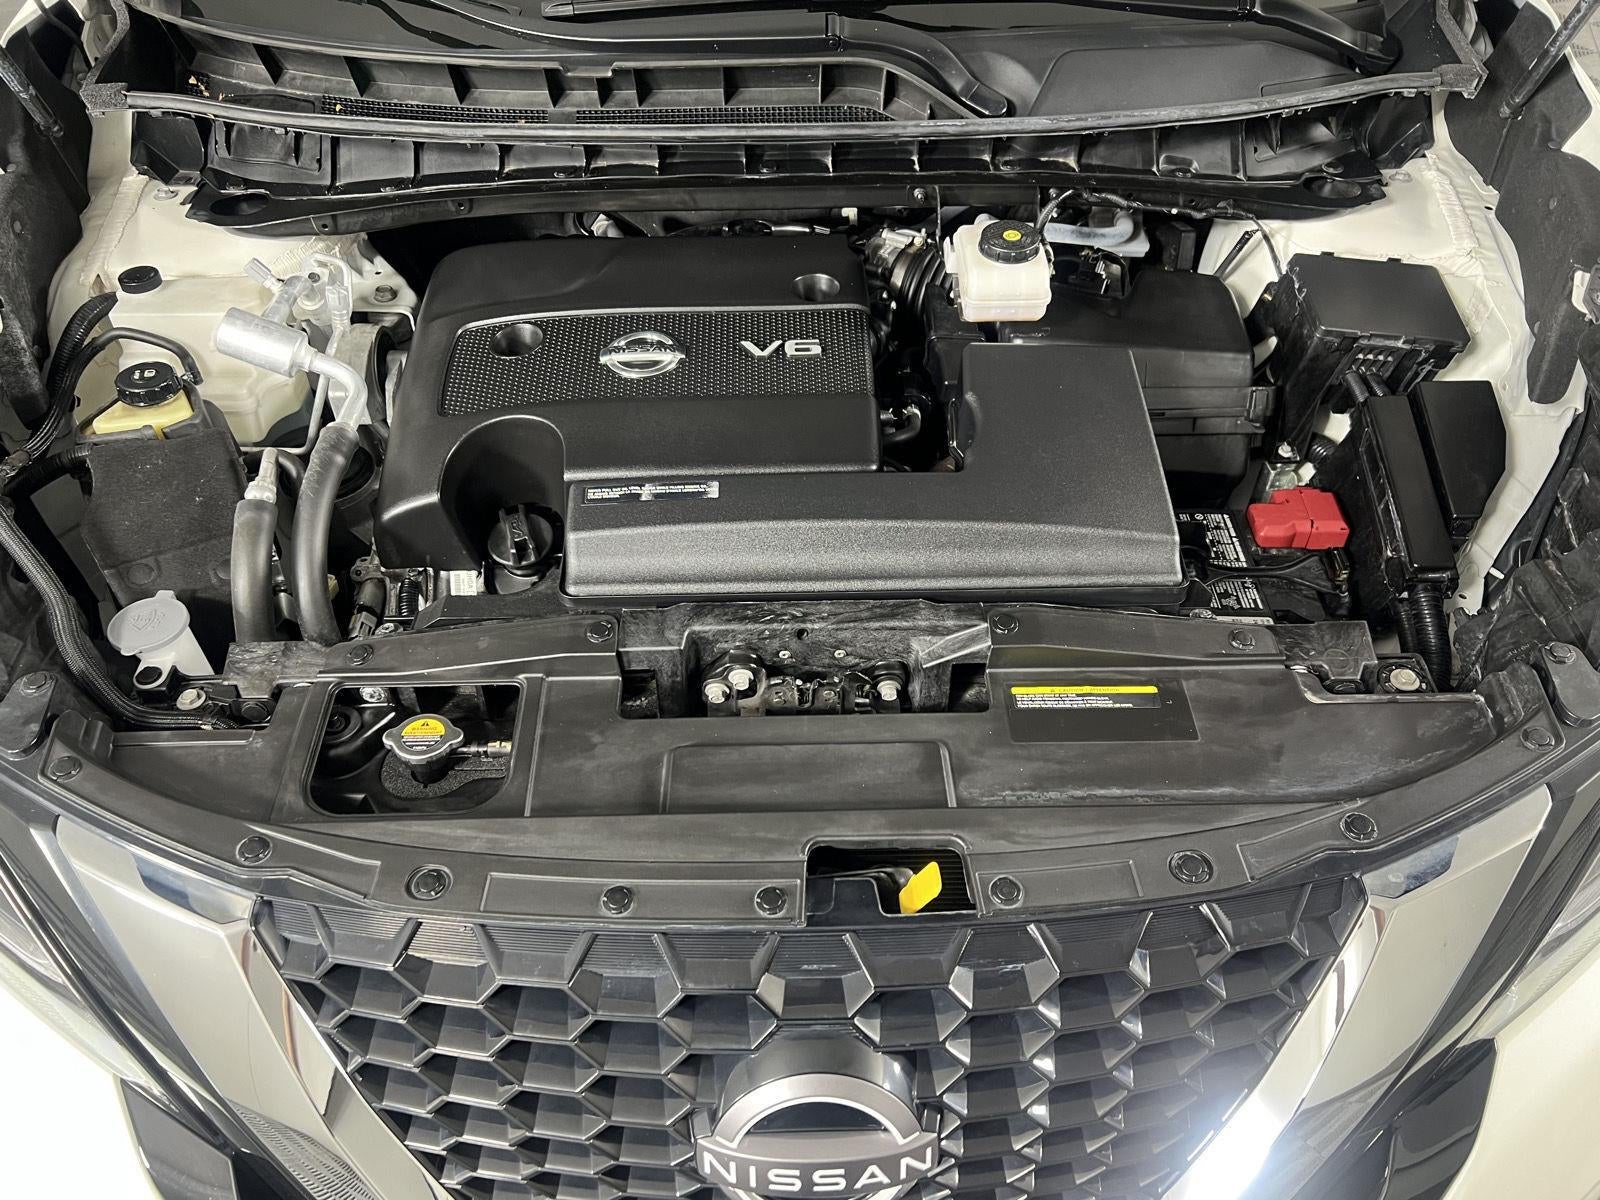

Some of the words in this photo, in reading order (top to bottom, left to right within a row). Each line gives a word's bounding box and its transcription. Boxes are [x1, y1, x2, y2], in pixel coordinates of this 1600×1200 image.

[608, 343, 677, 354] NISSAN
[739, 339, 822, 360] V6
[703, 1146, 933, 1193] NISSAN
